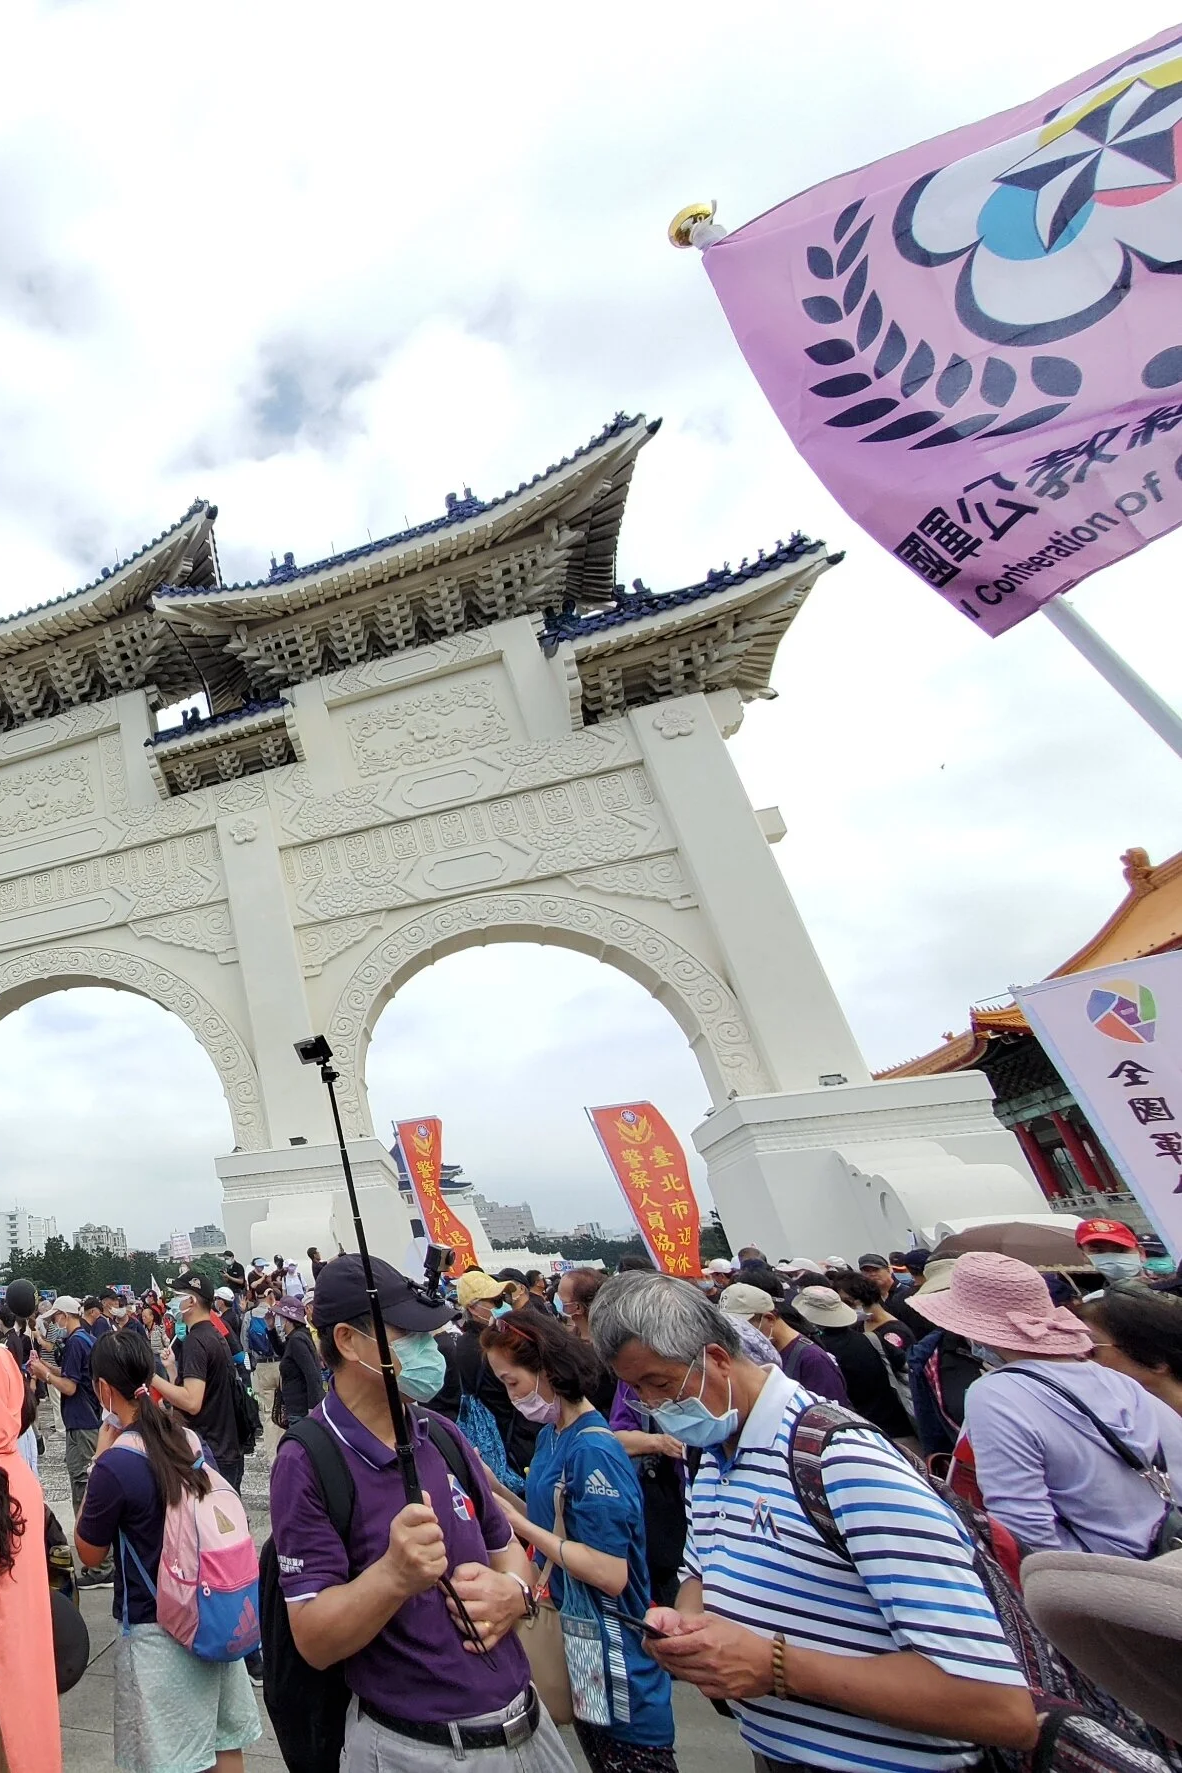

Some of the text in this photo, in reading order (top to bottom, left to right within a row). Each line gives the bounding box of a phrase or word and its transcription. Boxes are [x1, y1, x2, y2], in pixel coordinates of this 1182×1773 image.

[1115, 470, 1163, 517] of
[1107, 1060, 1182, 1194] 全國軍
[649, 1146, 693, 1273] 臺北市退休
